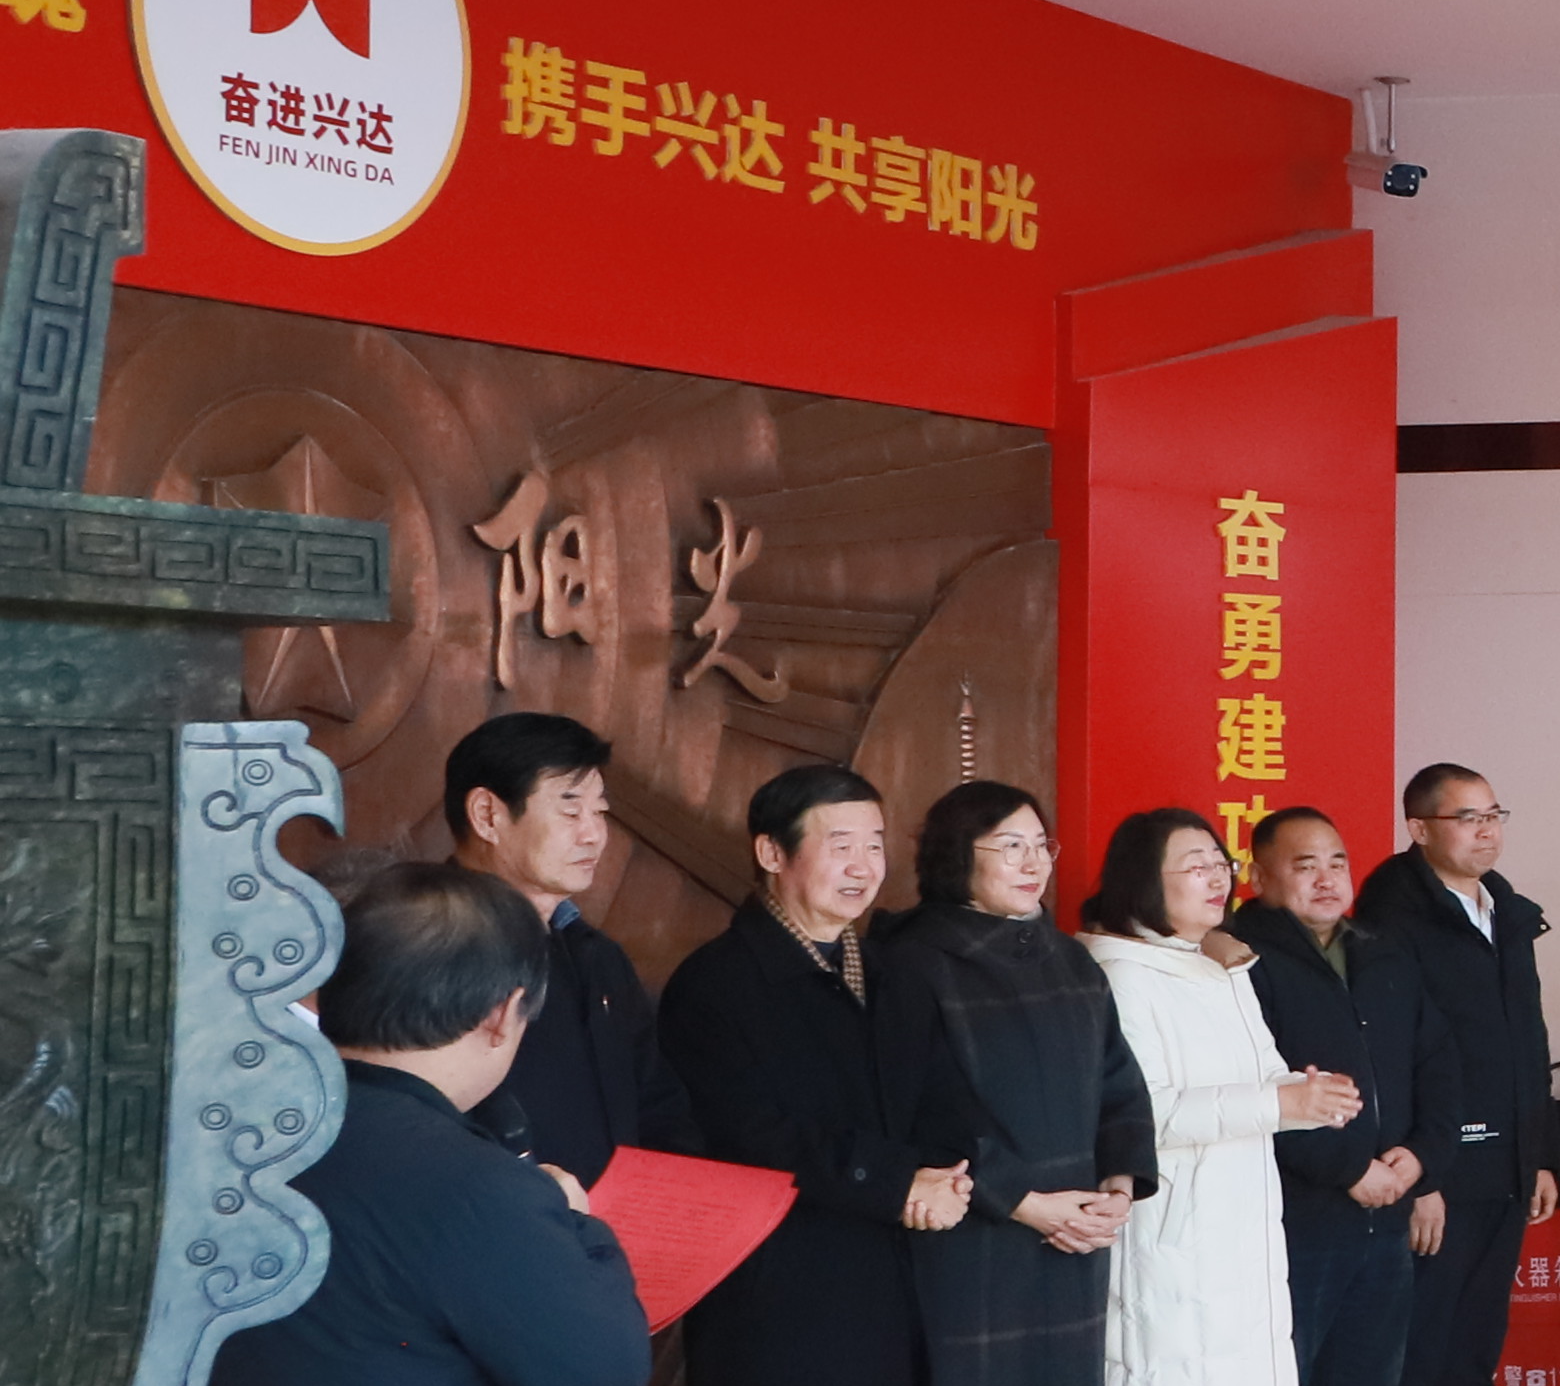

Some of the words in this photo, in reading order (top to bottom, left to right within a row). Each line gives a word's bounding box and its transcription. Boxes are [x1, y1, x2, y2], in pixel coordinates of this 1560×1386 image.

[220, 72, 394, 155] 奋进兴达
[502, 36, 785, 194] 携手兴达
[807, 117, 1038, 251] 共享阳光
[219, 134, 261, 159] FEN
[266, 146, 298, 166] JIN
[304, 151, 358, 178] XING
[365, 163, 394, 185] DA
